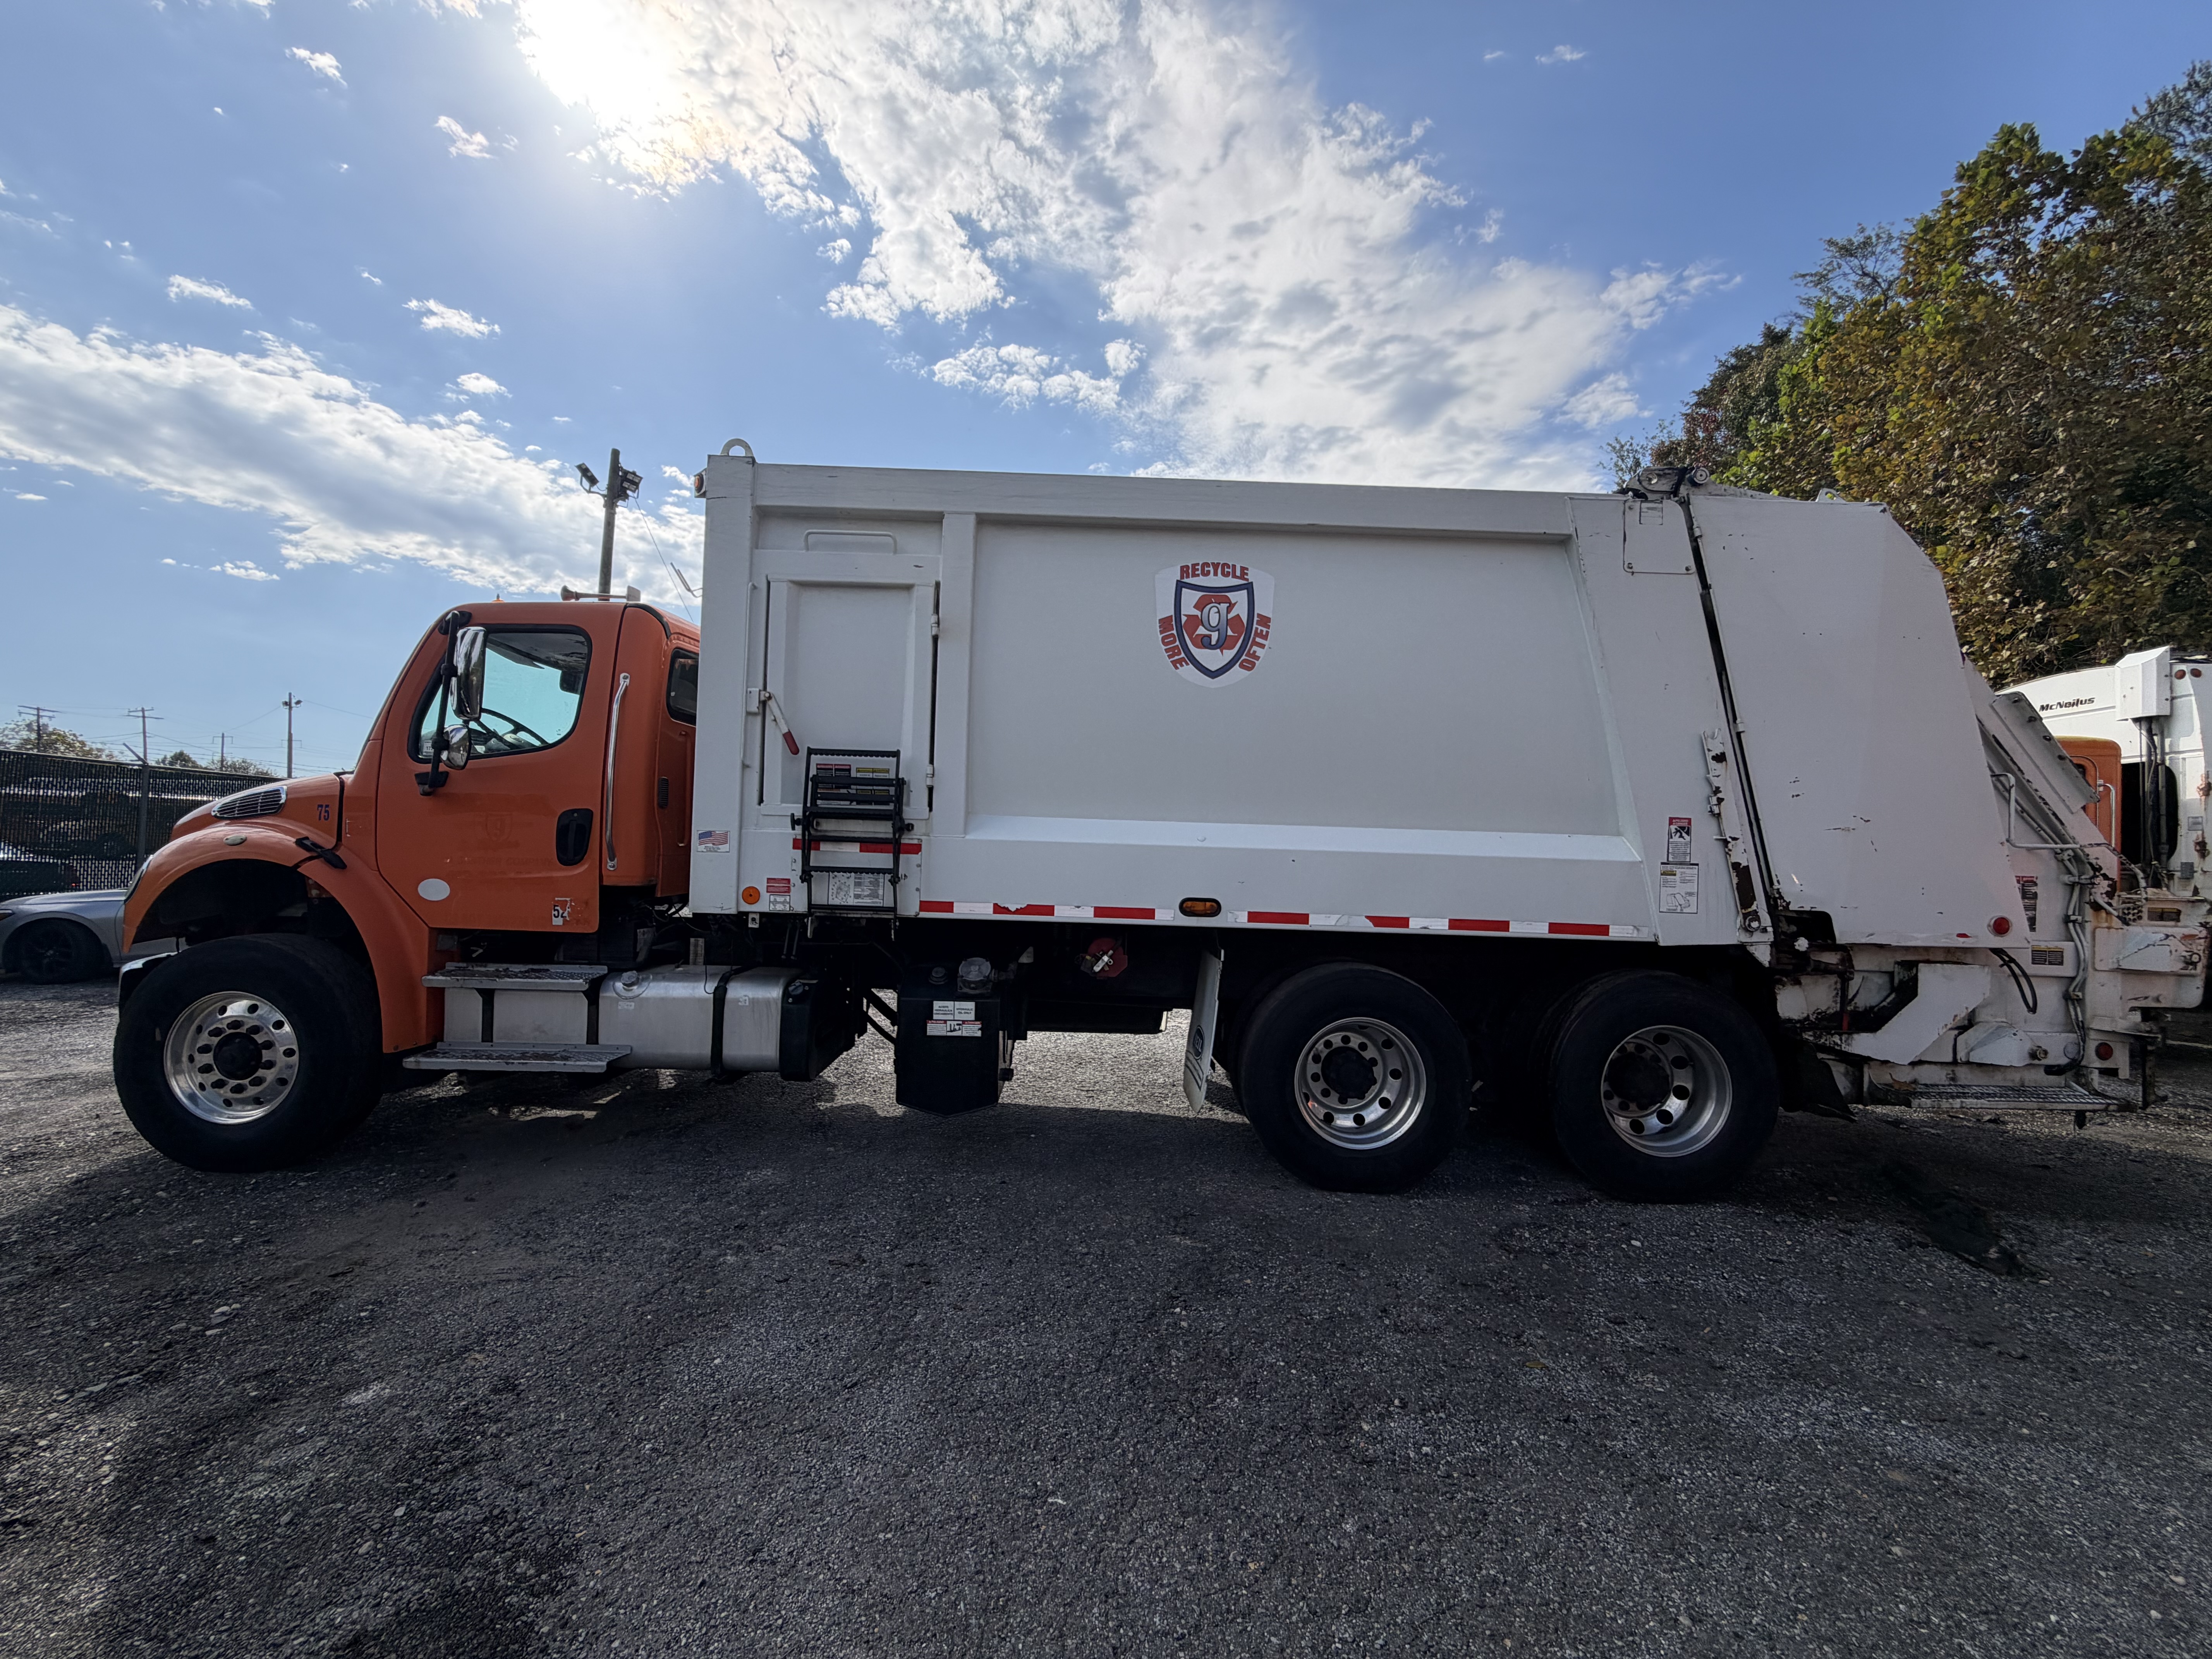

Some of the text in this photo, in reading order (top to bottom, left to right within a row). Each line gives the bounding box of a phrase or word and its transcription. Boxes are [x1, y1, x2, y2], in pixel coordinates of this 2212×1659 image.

[1180, 562, 1249, 582] RECYCLE
[1158, 615, 1190, 670] MORE
[1238, 613, 1271, 672] OFTEN
[2039, 697, 2095, 712] McNeilus
[317, 804, 330, 821] 75
